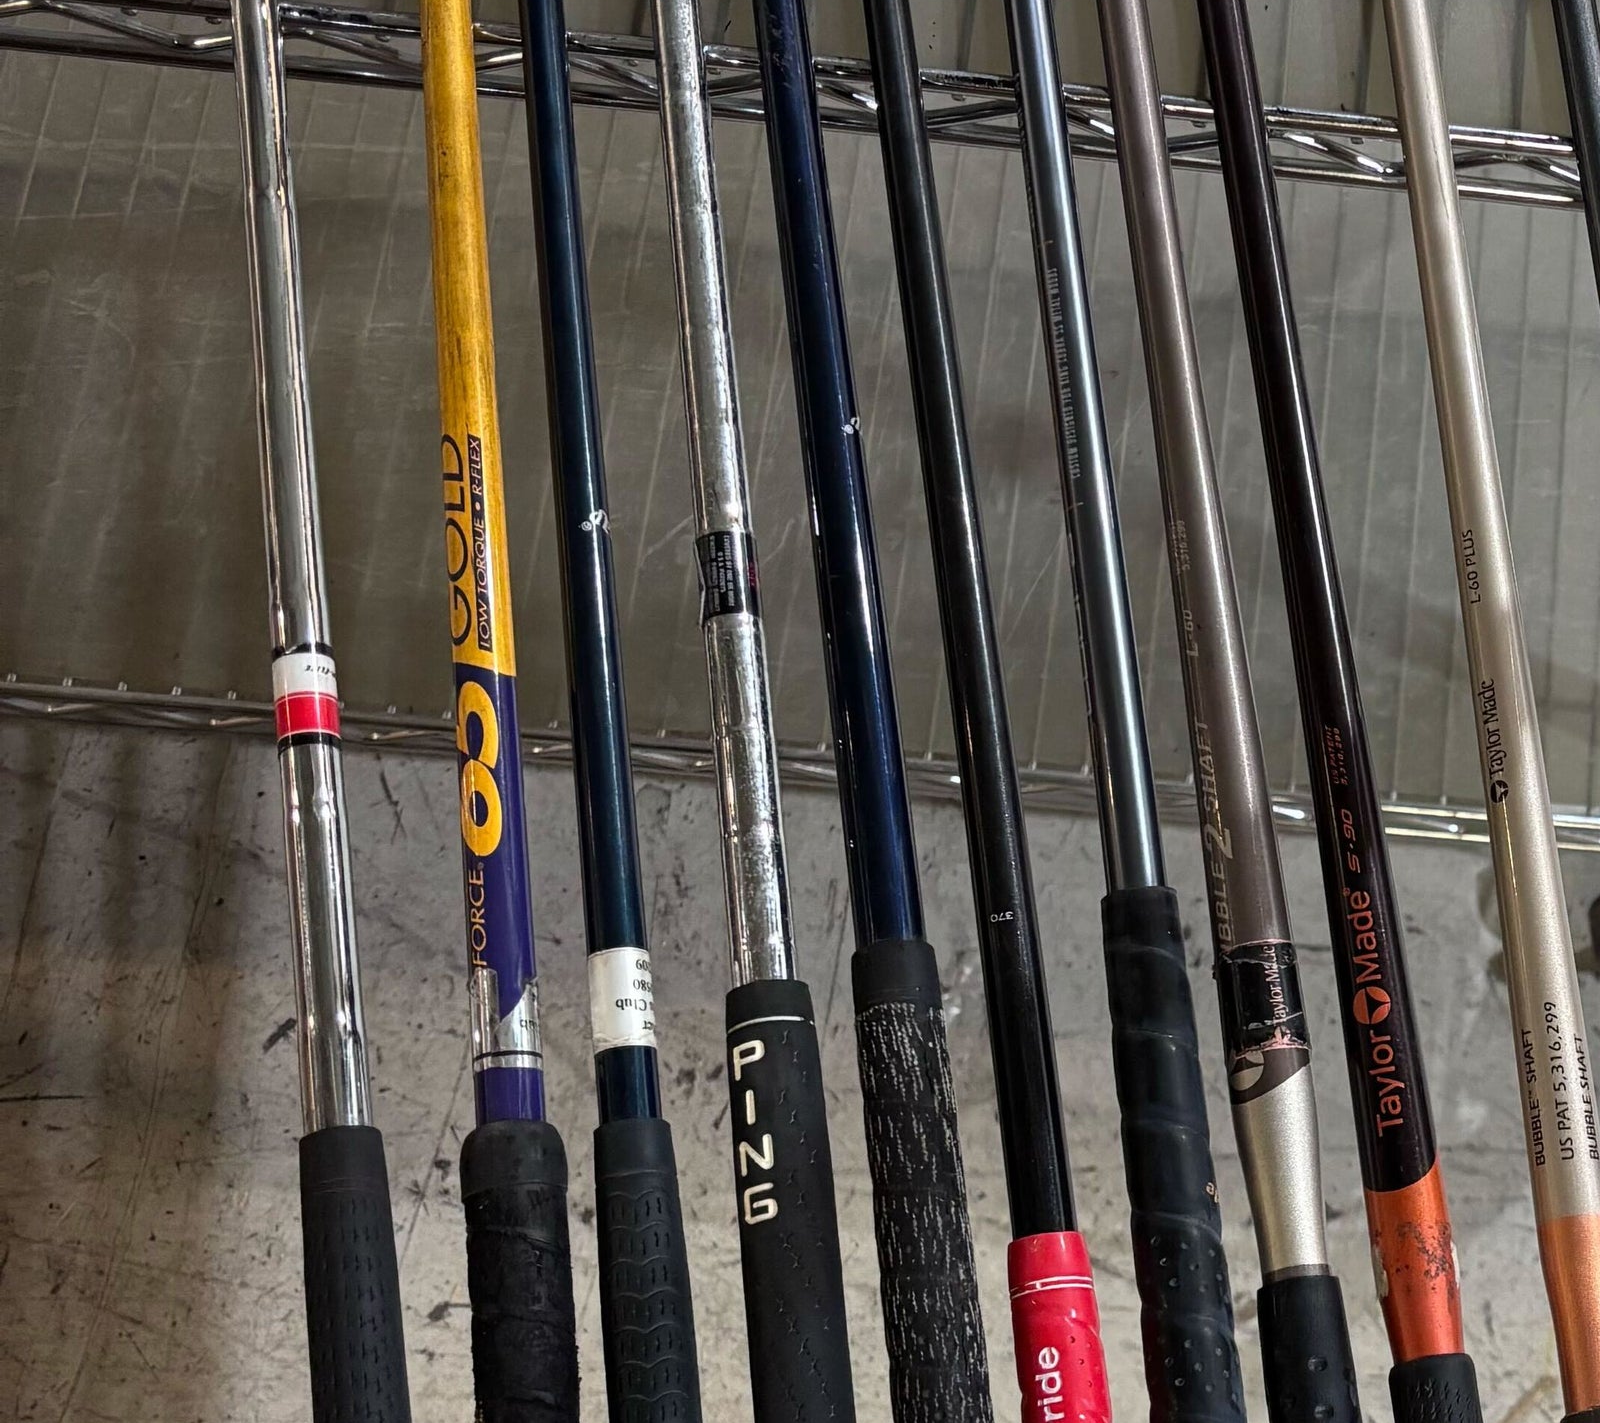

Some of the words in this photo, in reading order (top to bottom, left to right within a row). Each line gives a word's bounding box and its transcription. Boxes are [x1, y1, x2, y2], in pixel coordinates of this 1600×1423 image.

[467, 437, 483, 496] R-FLEX
[441, 434, 472, 647] GOLD
[471, 518, 490, 595] TORQUE
[1461, 528, 1477, 567] PLUS
[1467, 570, 1481, 605] L-60
[475, 600, 493, 650] LOW
[1477, 678, 1498, 725] Made
[457, 681, 502, 857] 65
[1194, 716, 1223, 813] SHAFT
[1485, 727, 1507, 780] Taylor
[1203, 826, 1234, 861] 2
[1210, 861, 1233, 955] BBLE
[615, 998, 648, 1012] Club
[1521, 1028, 1537, 1083] SHAFT
[1543, 1001, 1568, 1092] 5,316,299
[1574, 1032, 1590, 1090] SHAFT
[1366, 1027, 1405, 1137] Taylor
[732, 1038, 779, 1226] PING
[1554, 1098, 1572, 1130] PAT
[1581, 1093, 1600, 1161] BUBBLE
[1559, 1138, 1575, 1161] US
